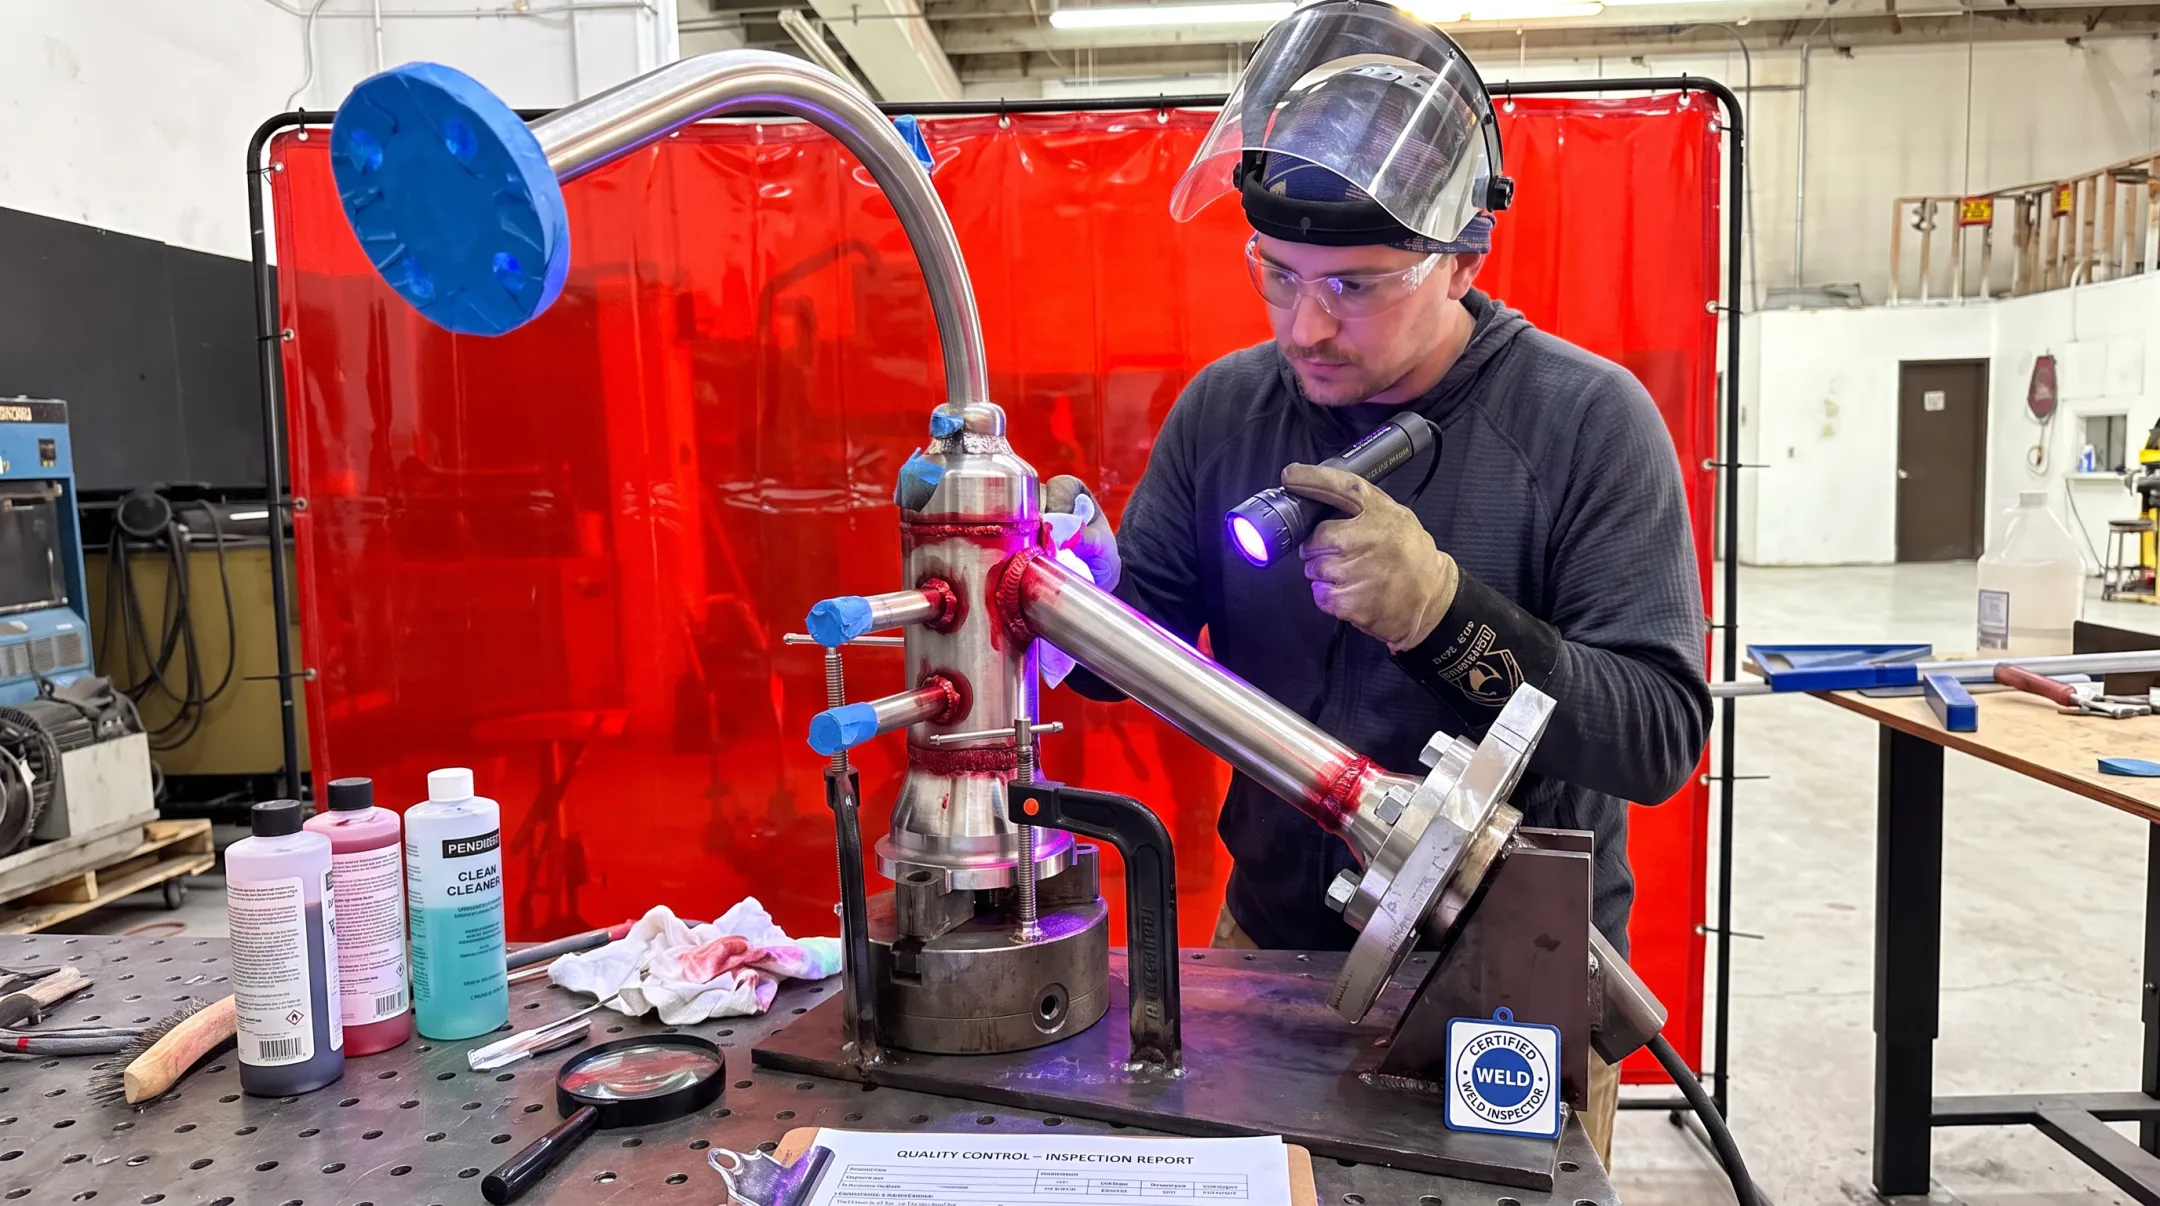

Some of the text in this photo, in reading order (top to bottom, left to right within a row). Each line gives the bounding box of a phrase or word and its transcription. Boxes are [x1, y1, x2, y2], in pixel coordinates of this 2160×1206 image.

[458, 864, 497, 882] CLEAN
[447, 876, 501, 896] CLEANER
[1470, 1035, 1536, 1061] CERTIFIED
[1476, 1067, 1531, 1087] WELD
[1462, 1081, 1544, 1120] WELD INSPECTOR
[896, 1150, 959, 1159] QUALITY
[962, 1151, 1030, 1161] CONTROL
[1045, 1152, 1132, 1164] INSPECTION
[1136, 1155, 1195, 1165] REPORT
